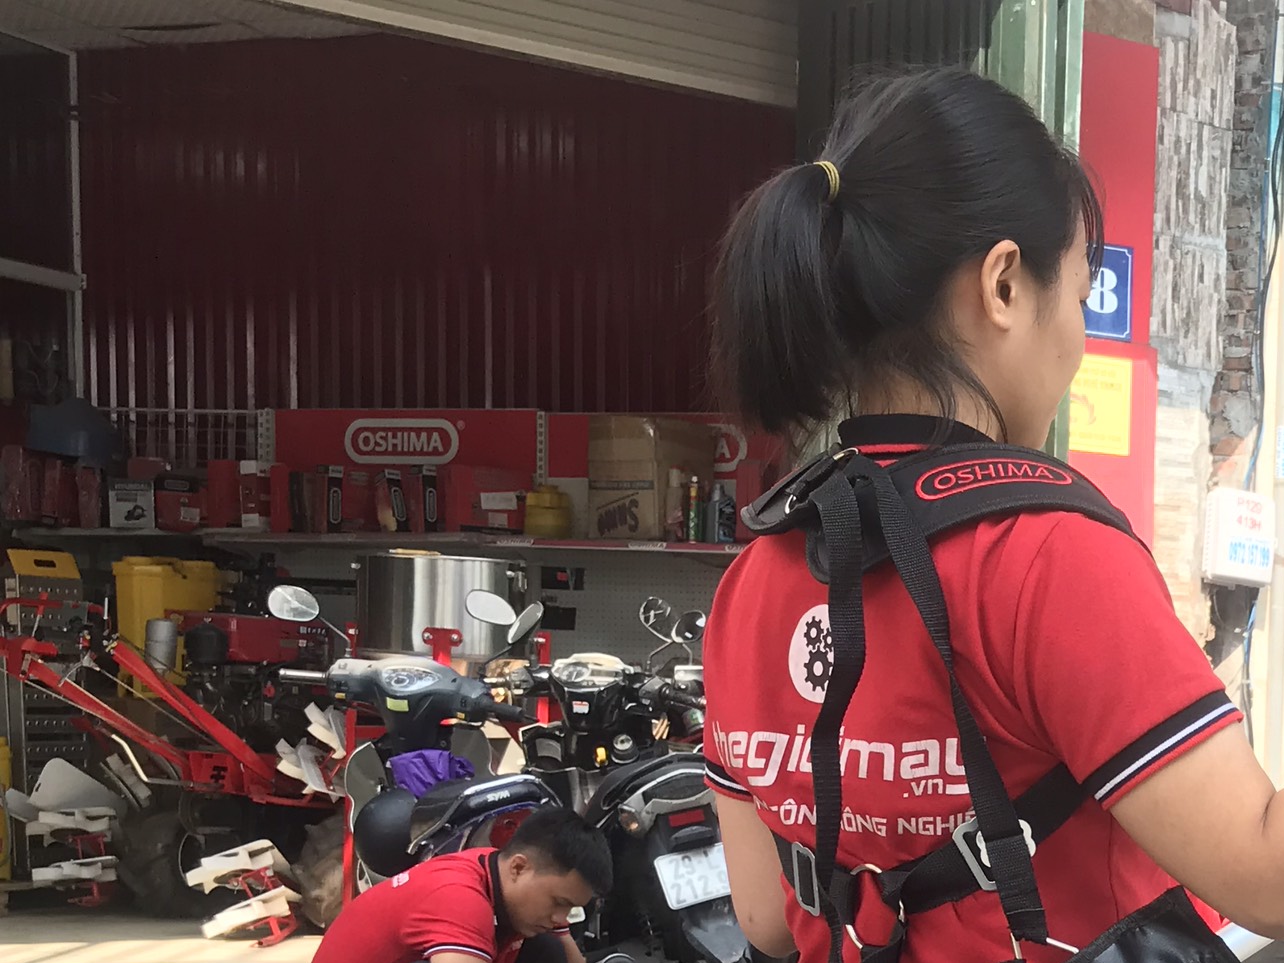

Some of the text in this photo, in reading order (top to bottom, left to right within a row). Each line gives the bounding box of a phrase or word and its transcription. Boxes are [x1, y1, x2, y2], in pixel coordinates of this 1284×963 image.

[357, 431, 444, 453] OSHIMA
[933, 462, 1055, 491] OSHIMA
[840, 805, 888, 837] ÔNG
